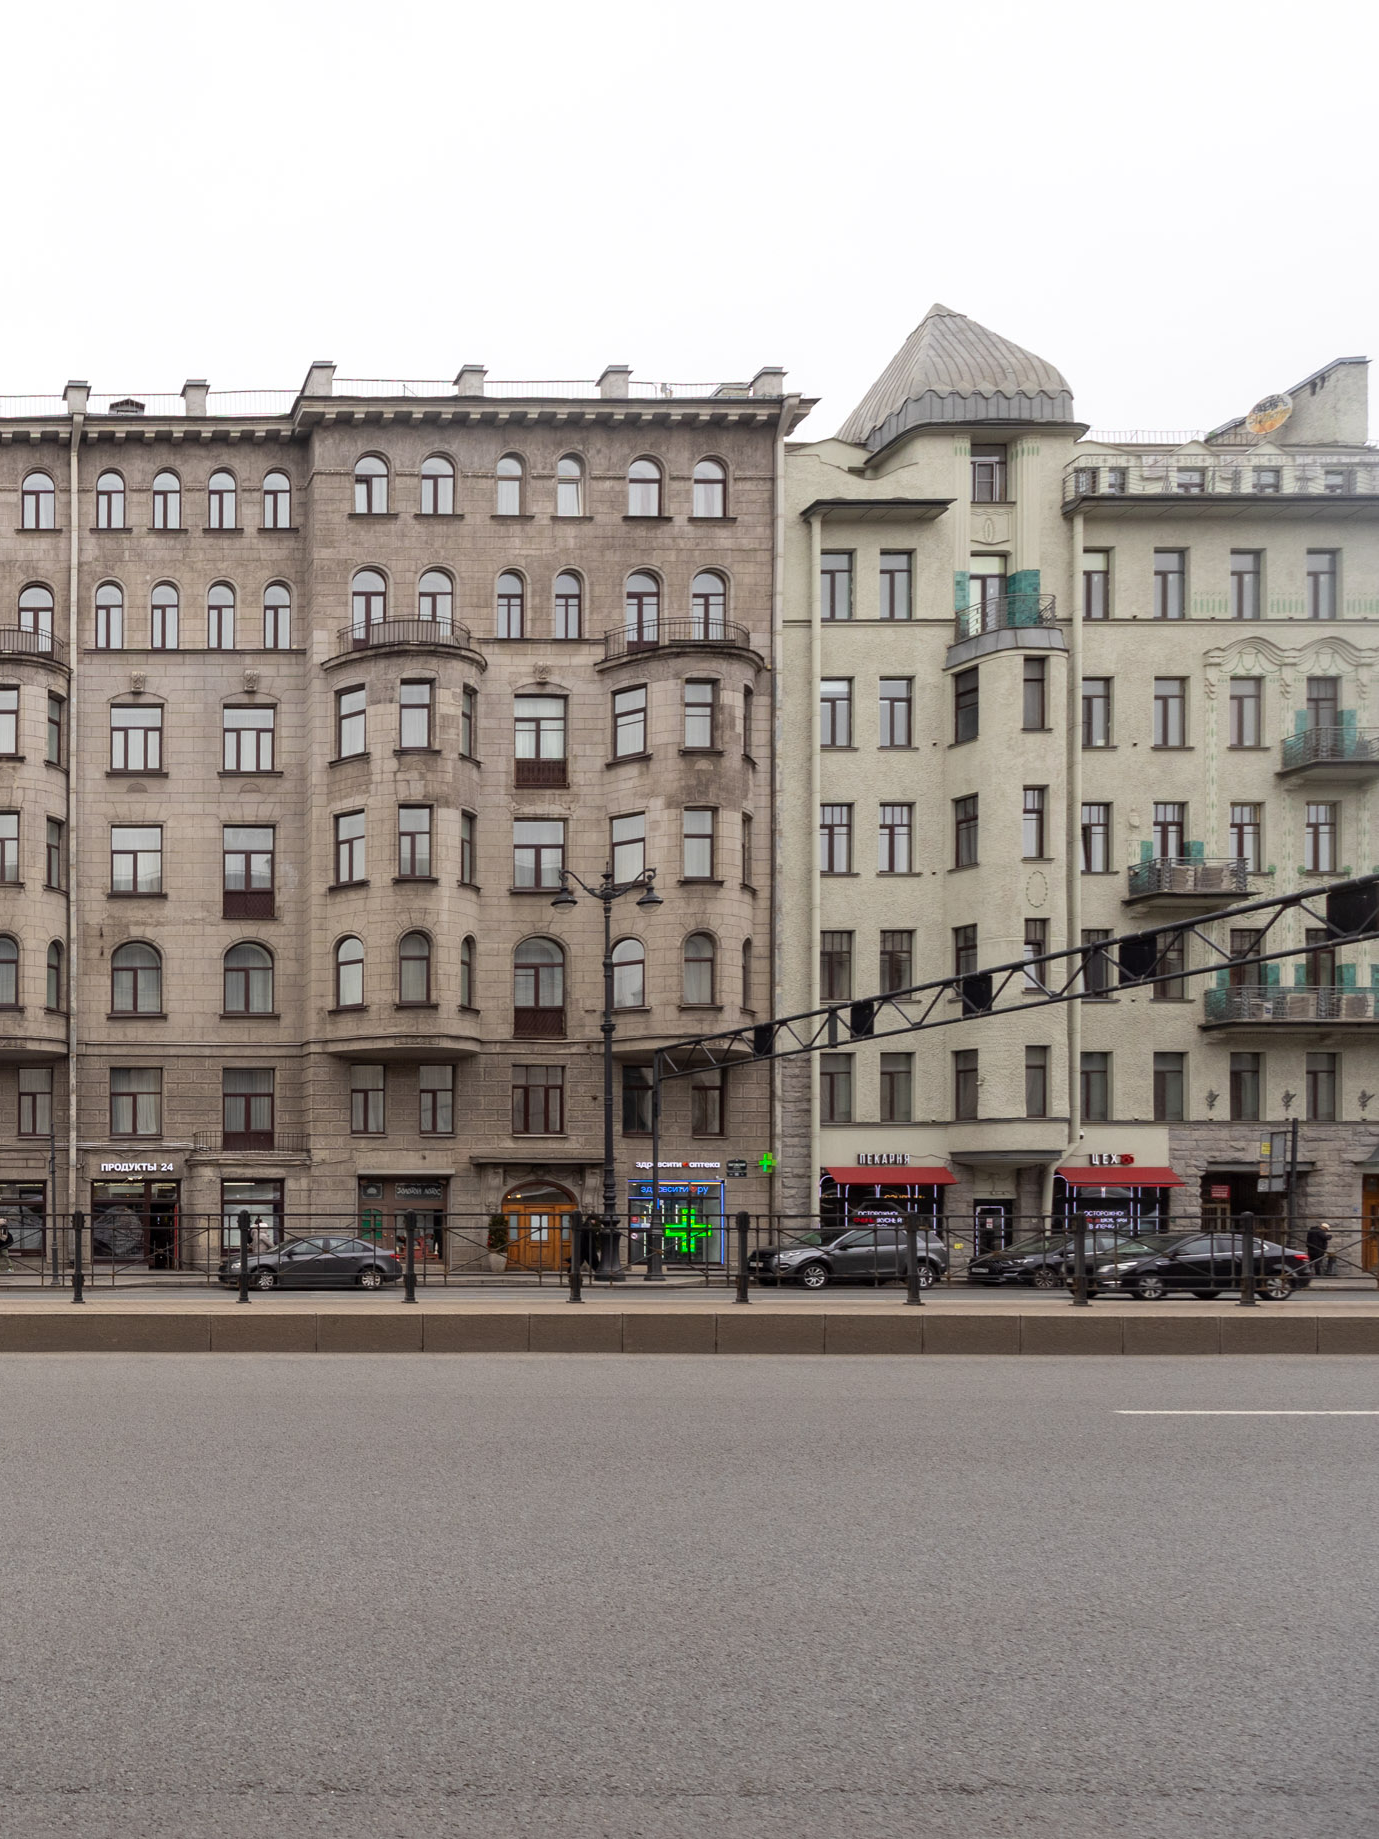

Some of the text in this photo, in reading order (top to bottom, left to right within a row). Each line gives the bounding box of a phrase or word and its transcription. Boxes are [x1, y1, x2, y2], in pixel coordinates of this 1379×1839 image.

[859, 1153, 910, 1165] ПЕКАРНЯ
[1092, 1153, 1118, 1165] ЦЕХ
[101, 1163, 174, 1172] ПРОДУКТЫ 24
[636, 1161, 682, 1169] здрвсити
